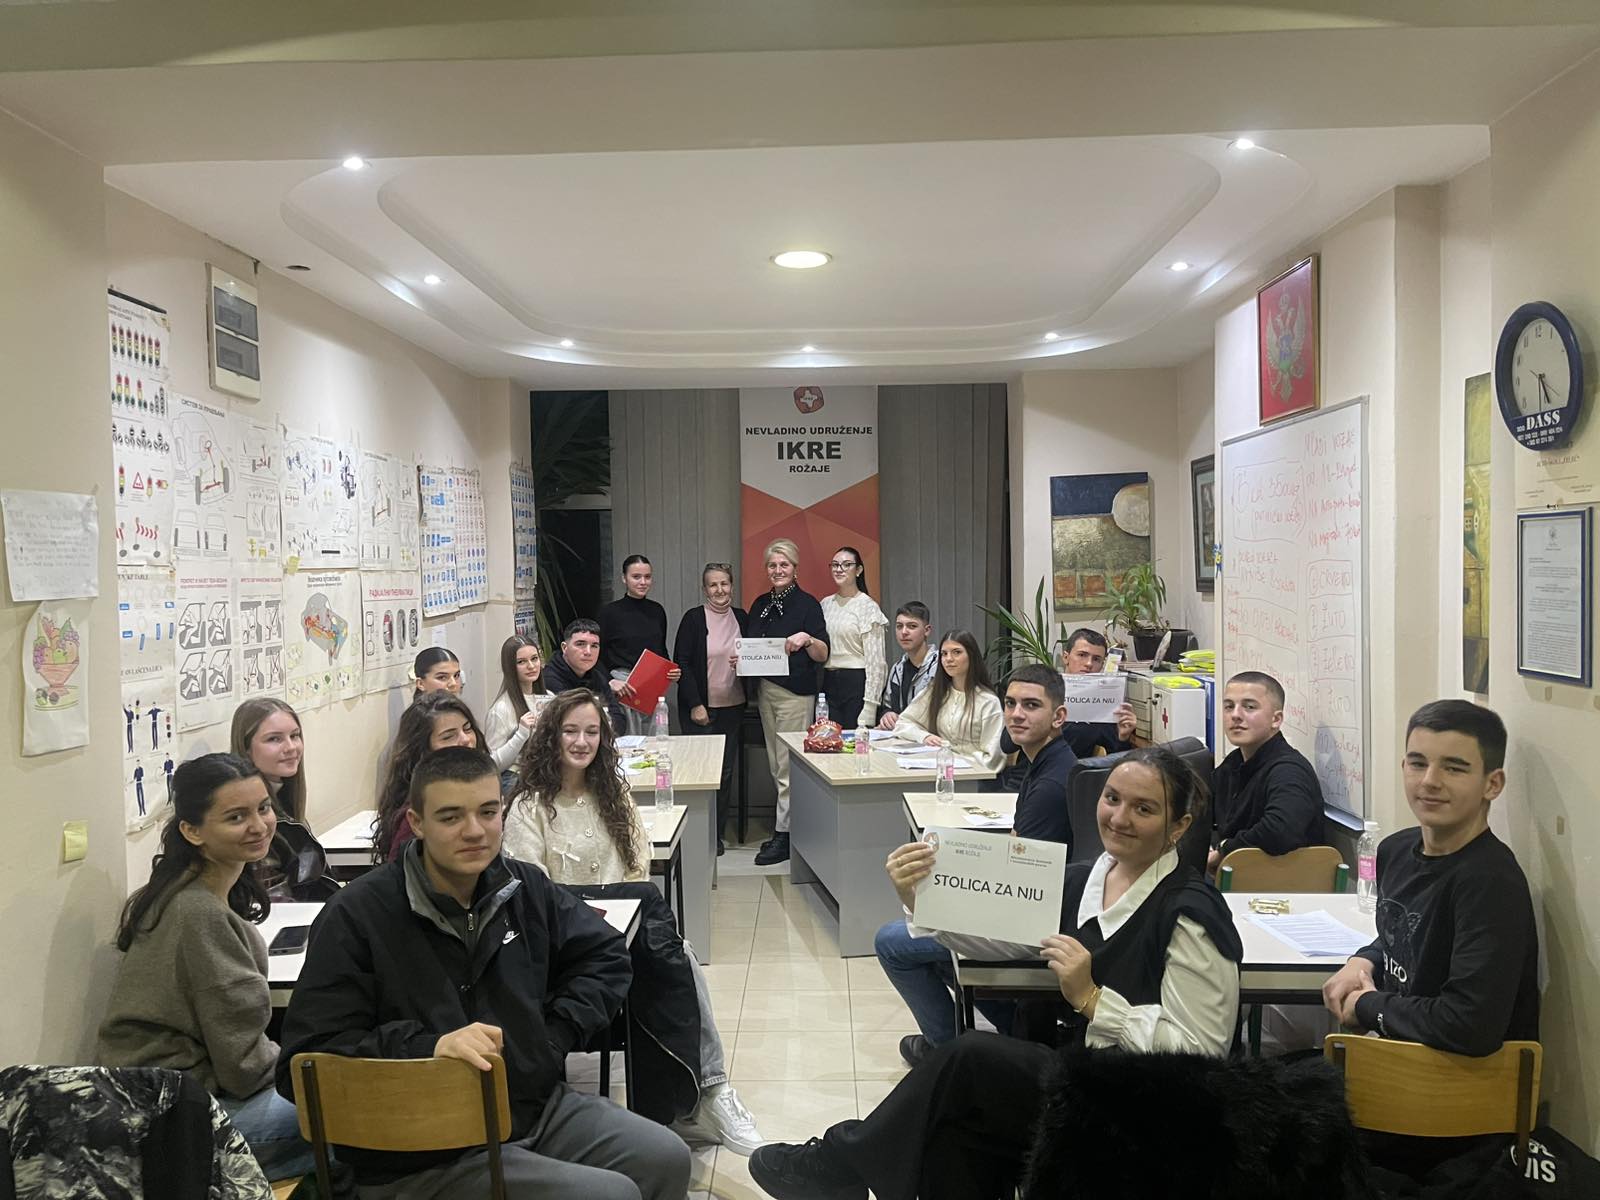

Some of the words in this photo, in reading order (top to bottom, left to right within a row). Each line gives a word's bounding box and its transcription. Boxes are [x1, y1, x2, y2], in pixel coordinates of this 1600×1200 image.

[1526, 410, 1560, 430] DASS
[745, 427, 806, 436] NEVLADINO
[810, 425, 873, 435] UDRUŽENJE
[777, 441, 842, 460] IKRE
[789, 464, 830, 473] ROŽAJE
[934, 874, 990, 893] STOLICA
[995, 883, 1013, 897] ZA
[1017, 886, 1044, 902] NJU
